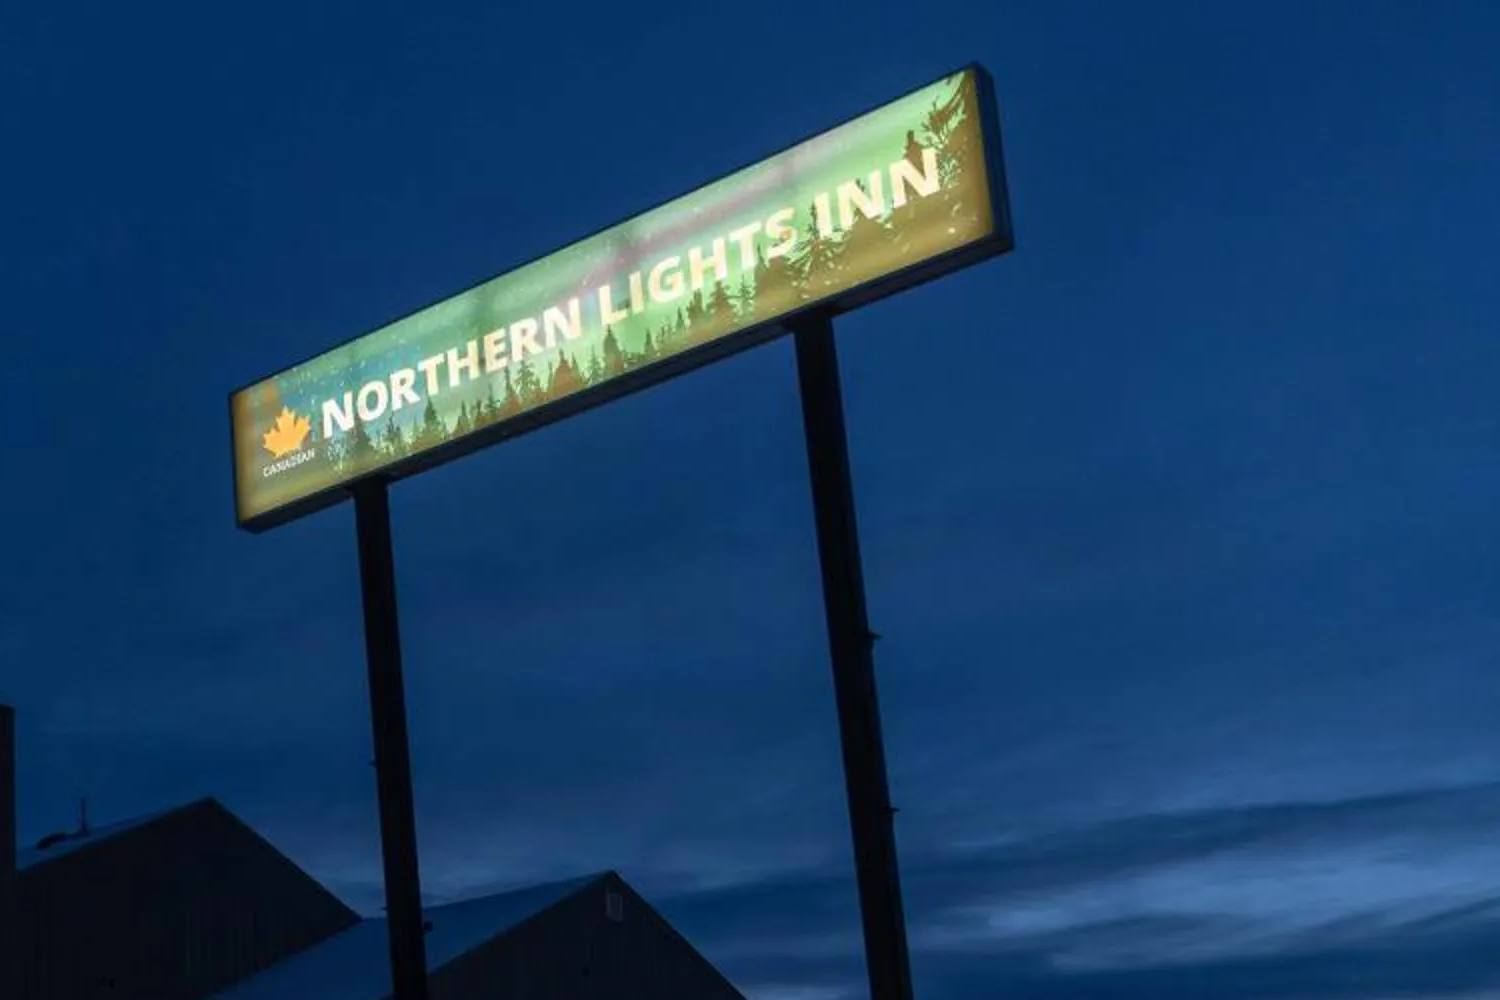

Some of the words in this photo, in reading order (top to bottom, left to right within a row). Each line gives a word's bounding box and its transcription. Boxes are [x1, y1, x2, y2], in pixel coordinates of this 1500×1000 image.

[322, 299, 582, 438] NORTHERN
[599, 207, 799, 326] LIGHTS
[814, 148, 940, 239] INN
[263, 448, 315, 477] CANADIAN
